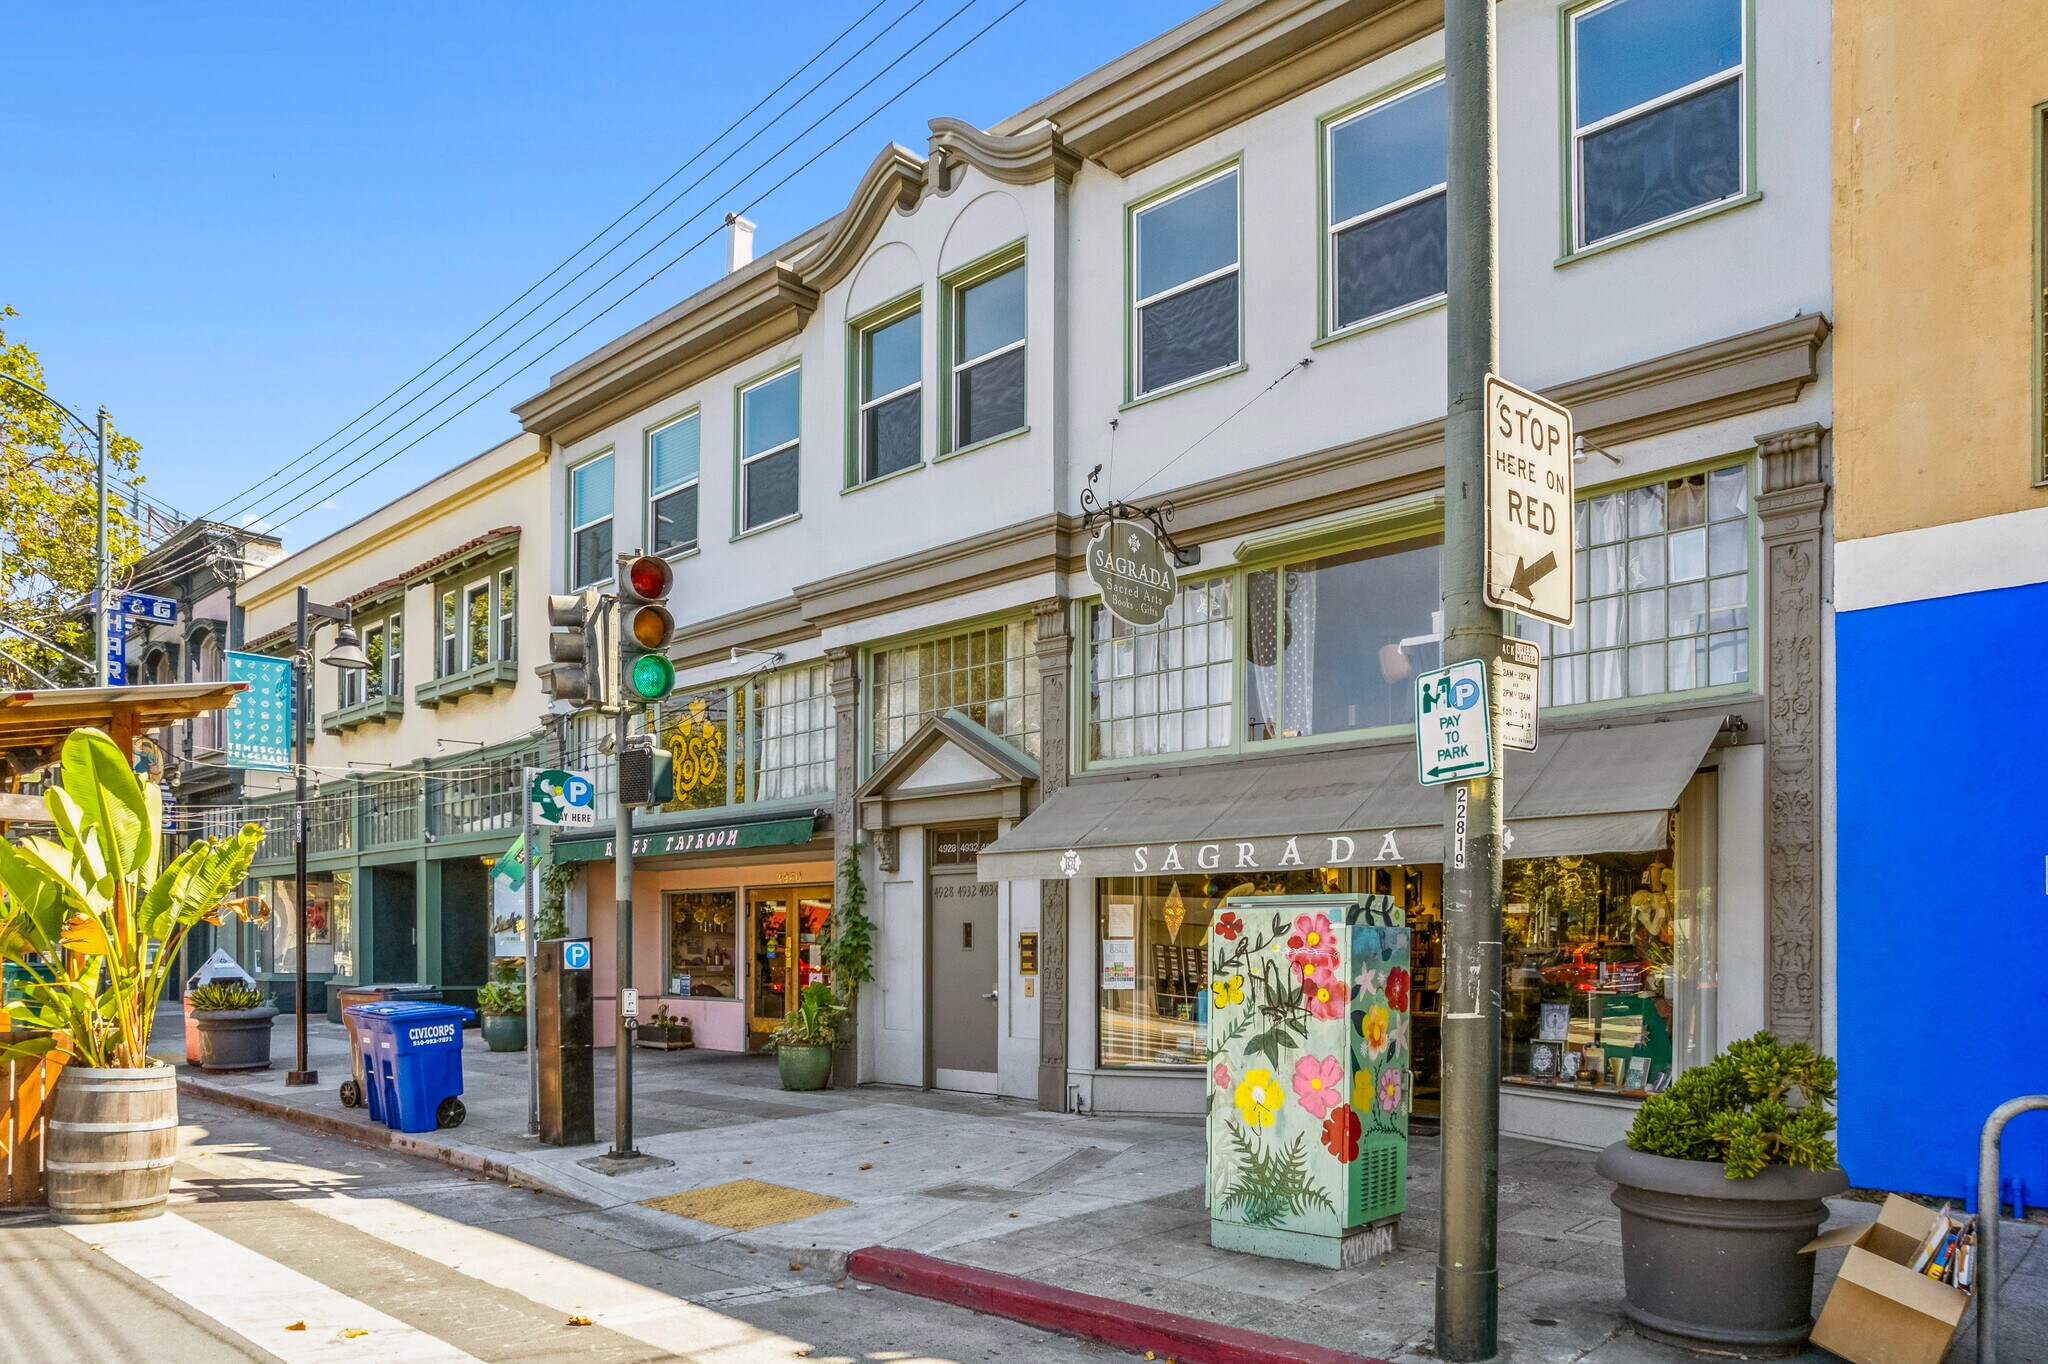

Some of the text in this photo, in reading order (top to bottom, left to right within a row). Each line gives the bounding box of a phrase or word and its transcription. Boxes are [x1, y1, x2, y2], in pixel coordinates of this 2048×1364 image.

[1499, 403, 1560, 456] STOP
[1496, 449, 1564, 495] HERE ON
[1508, 488, 1556, 536] RED
[1095, 549, 1171, 590] SAGRADA
[1106, 577, 1163, 606] Sacred Arts
[1112, 593, 1133, 610] Books
[1140, 602, 1158, 617] Gifts
[1501, 643, 1515, 656] ACK
[1516, 653, 1536, 664] MATTER
[1502, 668, 1513, 678] 2AM
[1455, 683, 1475, 707] P
[1502, 688, 1514, 699] 2PM
[1439, 714, 1461, 730] PAY
[1445, 730, 1460, 744] TO
[228, 743, 288, 755] TEMESCAL
[228, 751, 289, 762] TELEGRAPH
[1437, 744, 1469, 762] PARK
[569, 781, 587, 803] P
[556, 813, 592, 823] AY HERE
[1455, 788, 1466, 867] 22819
[605, 829, 739, 857] RES' TAPROOM
[938, 844, 957, 853] 4928
[960, 842, 979, 852] 4932
[1133, 829, 1404, 873] SAGRADA
[934, 886, 954, 898] 4928
[957, 885, 977, 897] 4932
[571, 946, 585, 966] P
[408, 1023, 455, 1040] CIVICORPS
[412, 1036, 453, 1047] 510-992-7871
